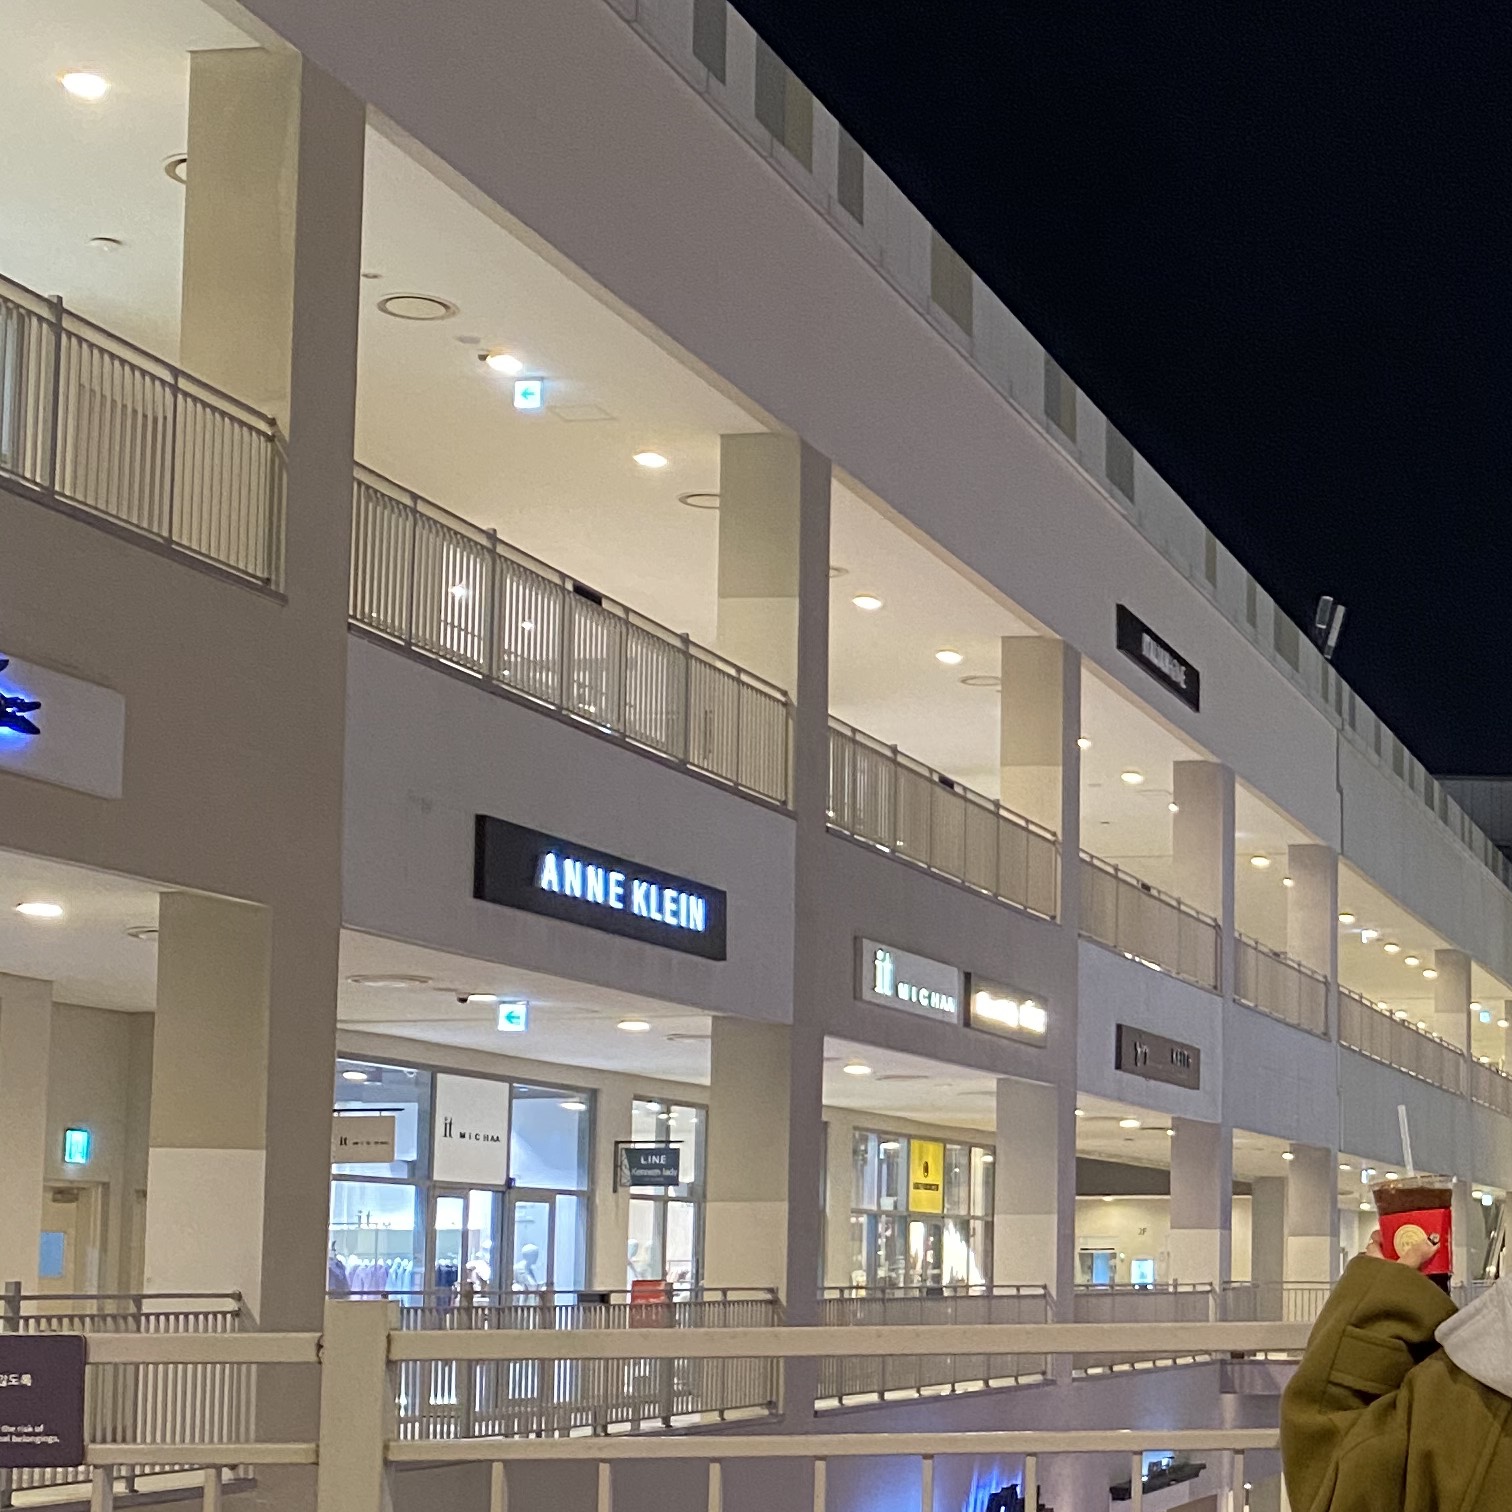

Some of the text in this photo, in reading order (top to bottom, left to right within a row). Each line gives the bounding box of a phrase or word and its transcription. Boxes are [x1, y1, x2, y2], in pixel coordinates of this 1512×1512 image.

[540, 851, 706, 932] ANNE KLEIN
[443, 1116, 453, 1138] it
[640, 1154, 667, 1165] LINE
